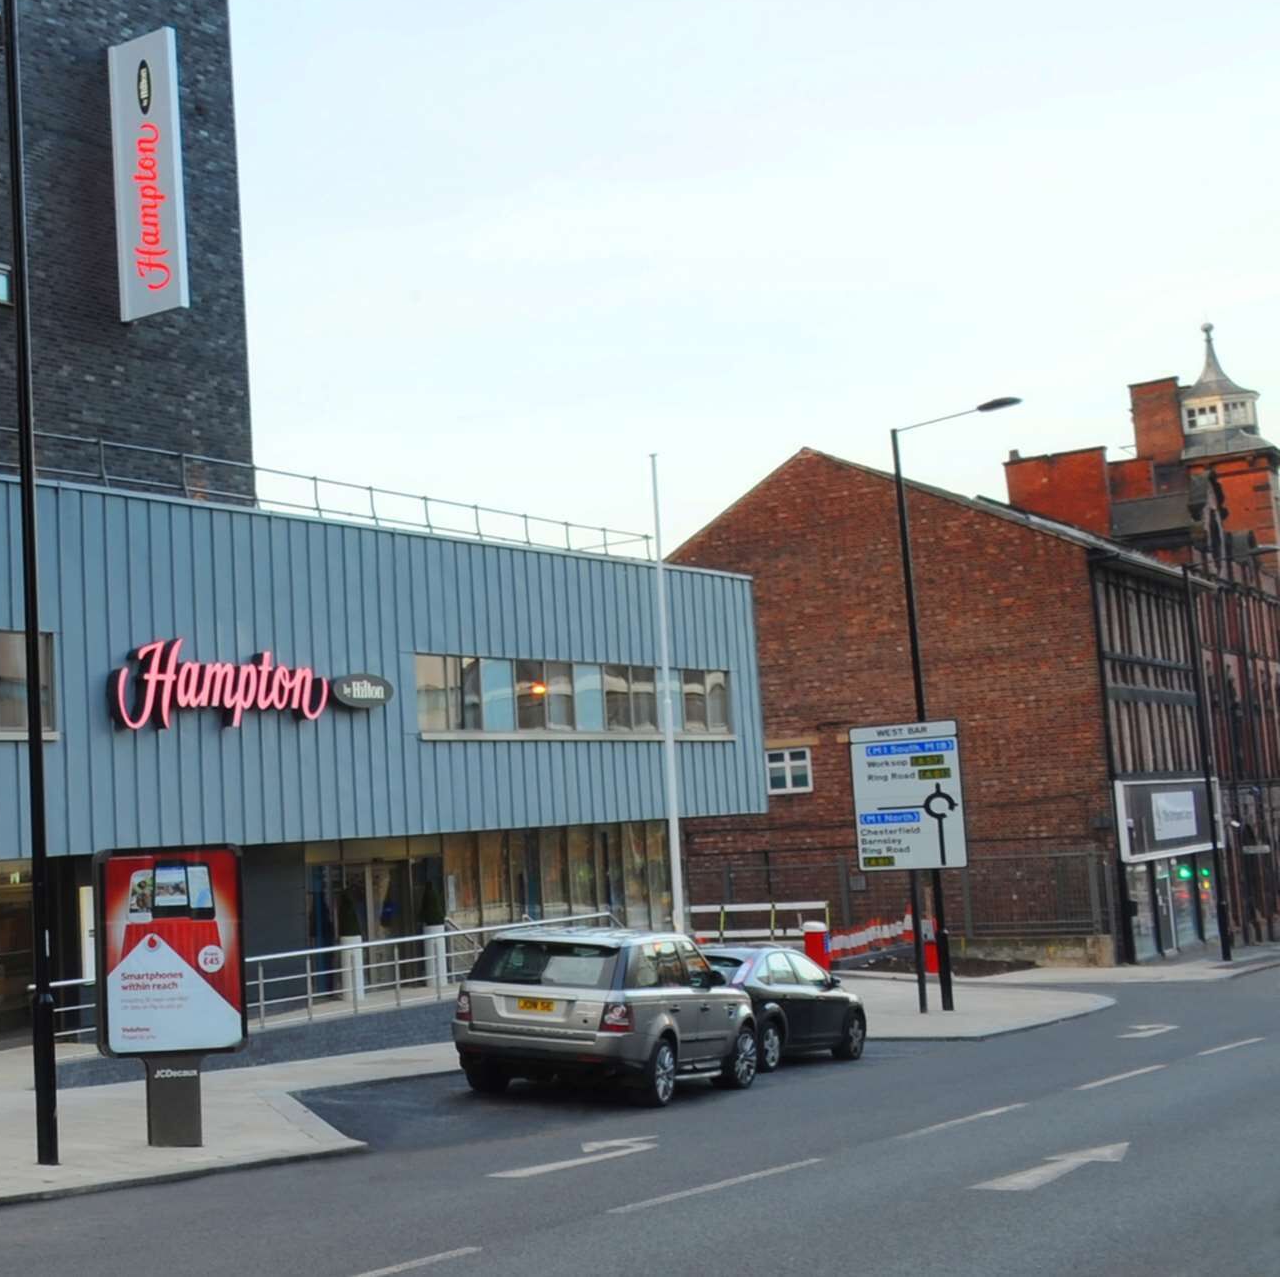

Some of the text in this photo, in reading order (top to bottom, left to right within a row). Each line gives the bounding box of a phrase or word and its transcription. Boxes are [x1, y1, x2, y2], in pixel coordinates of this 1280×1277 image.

[133, 122, 172, 290] Hampton
[117, 638, 329, 730] Hampton
[352, 680, 385, 699] Hilton
[876, 726, 928, 737] WEST BAR
[867, 760, 908, 769] Worksop
[867, 774, 889, 783] Ring
[891, 772, 916, 780] Road
[861, 827, 921, 837] Chesterfield
[861, 847, 883, 855] Ring
[121, 971, 183, 982] Smartphones
[121, 981, 178, 991] within reach
[154, 1069, 198, 1079] JCDecaux
